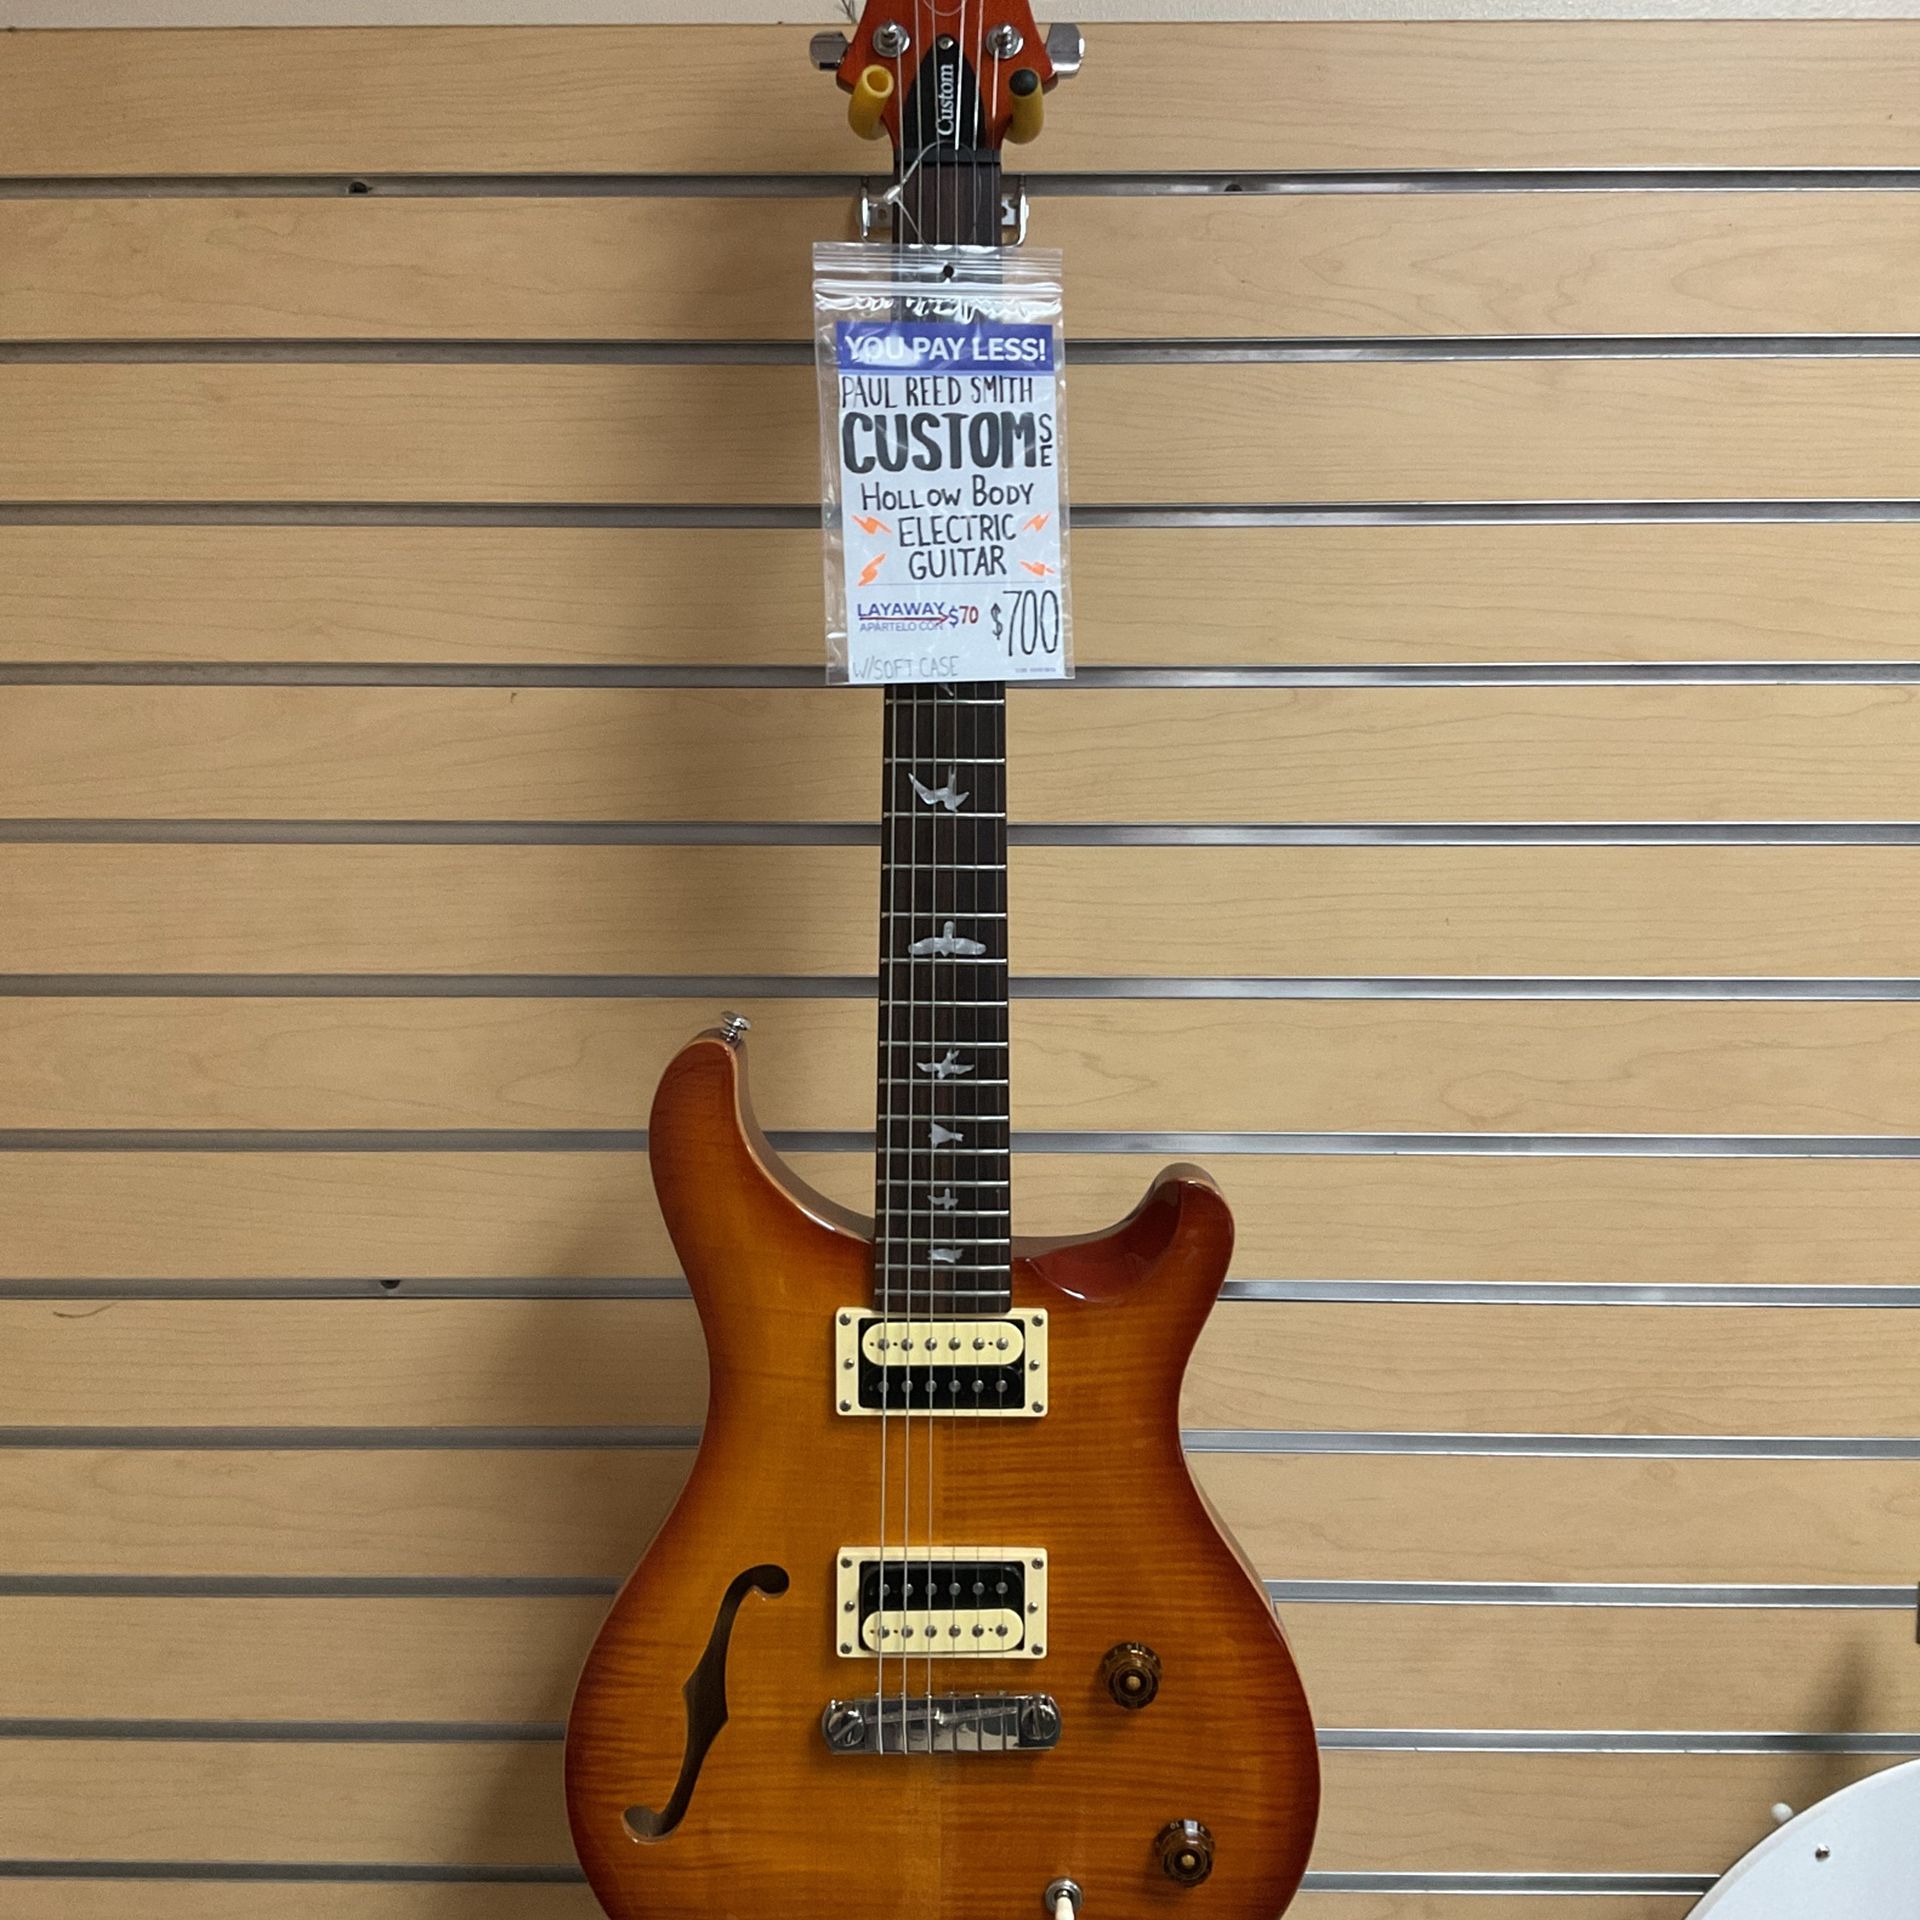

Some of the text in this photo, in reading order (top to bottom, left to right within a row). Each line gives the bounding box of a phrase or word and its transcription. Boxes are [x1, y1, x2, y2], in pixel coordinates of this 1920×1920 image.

[936, 64, 954, 136] Custom
[845, 336, 1046, 362] YOU PAY LESS!
[841, 375, 1033, 408] PAUL REED SMITH
[842, 411, 1036, 474] CUSTOM
[898, 513, 1017, 547] ELECTRIC
[908, 545, 1007, 580] GUITAR
[857, 602, 979, 628] LAYAWAY $70
[860, 622, 917, 632] APARTELO
[991, 590, 1059, 657] $700
[920, 656, 959, 678] CASE
